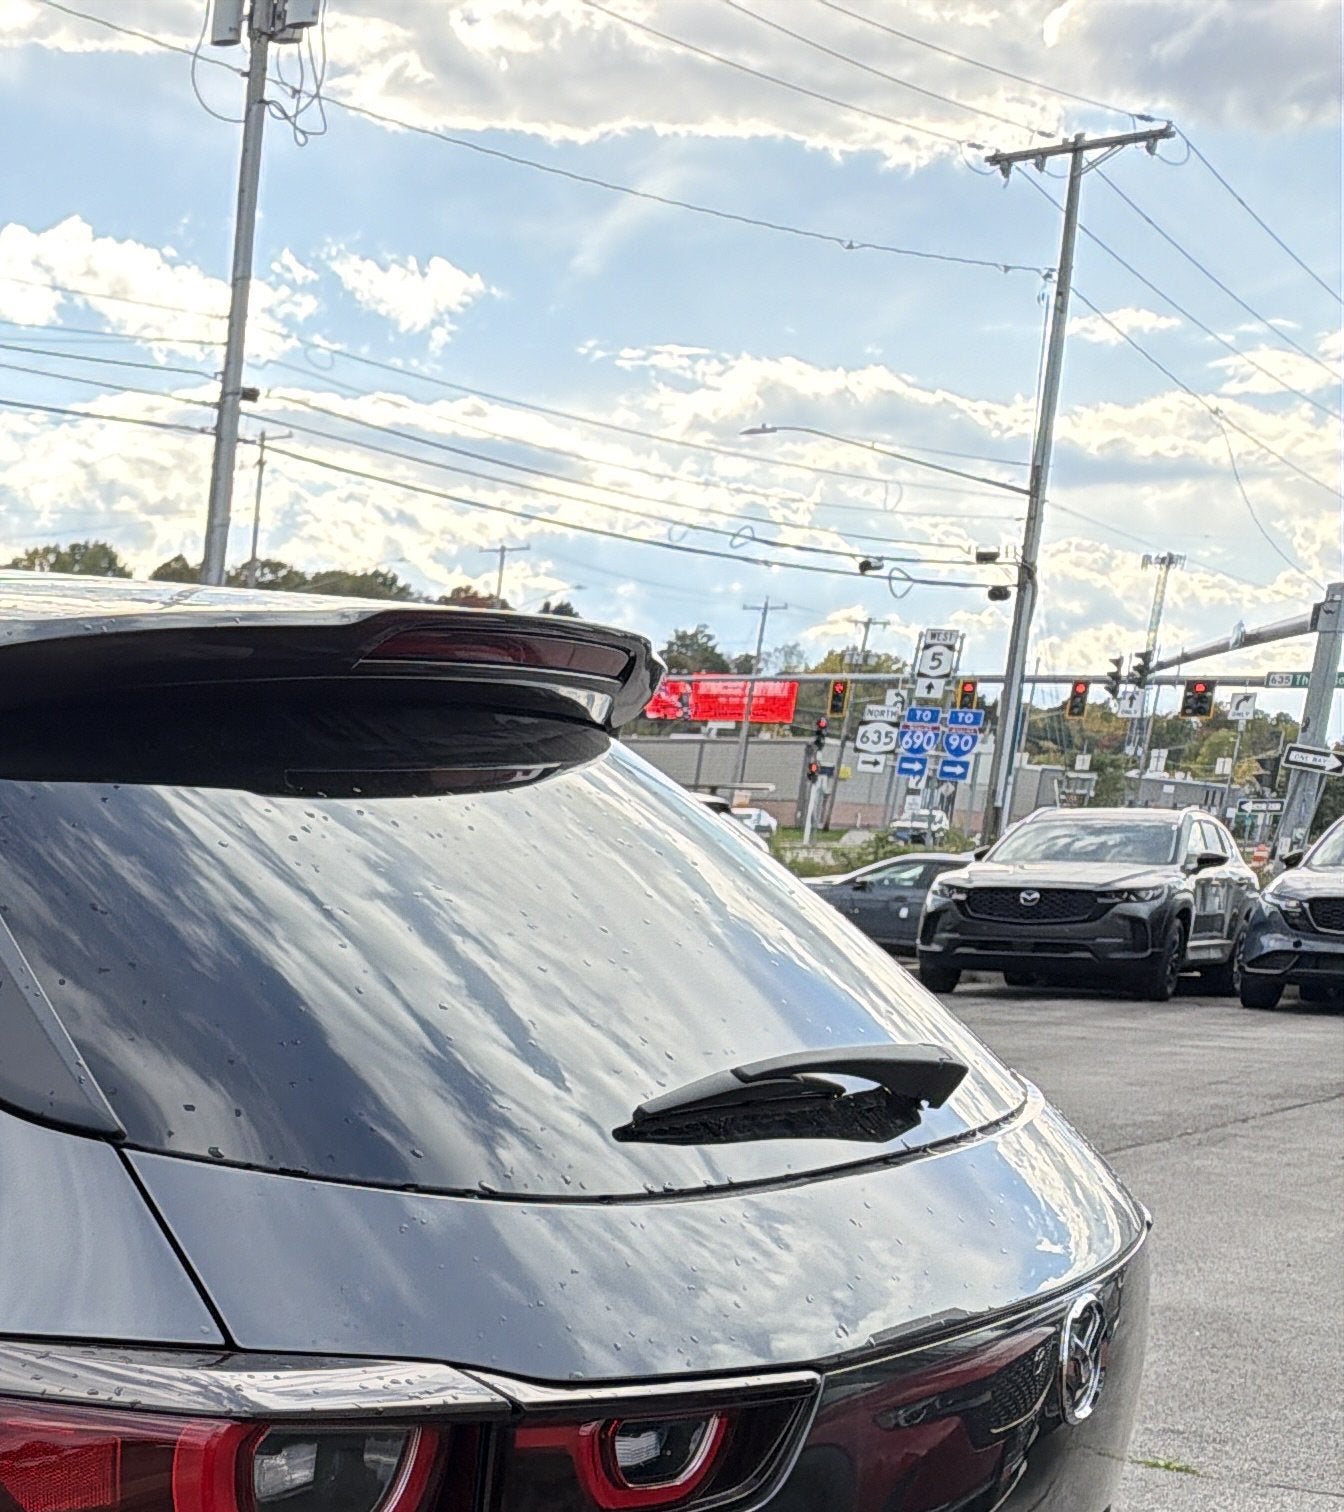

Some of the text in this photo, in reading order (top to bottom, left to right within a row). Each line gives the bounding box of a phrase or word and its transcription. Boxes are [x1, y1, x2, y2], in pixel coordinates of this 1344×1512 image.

[930, 631, 957, 641] WEST
[929, 652, 943, 670] 5
[1271, 675, 1291, 684] 635
[867, 708, 898, 718] NORTH
[915, 709, 932, 721] TO
[958, 711, 974, 723] TO
[859, 729, 894, 746] 635
[901, 730, 935, 749] 690
[948, 733, 973, 751] 90
